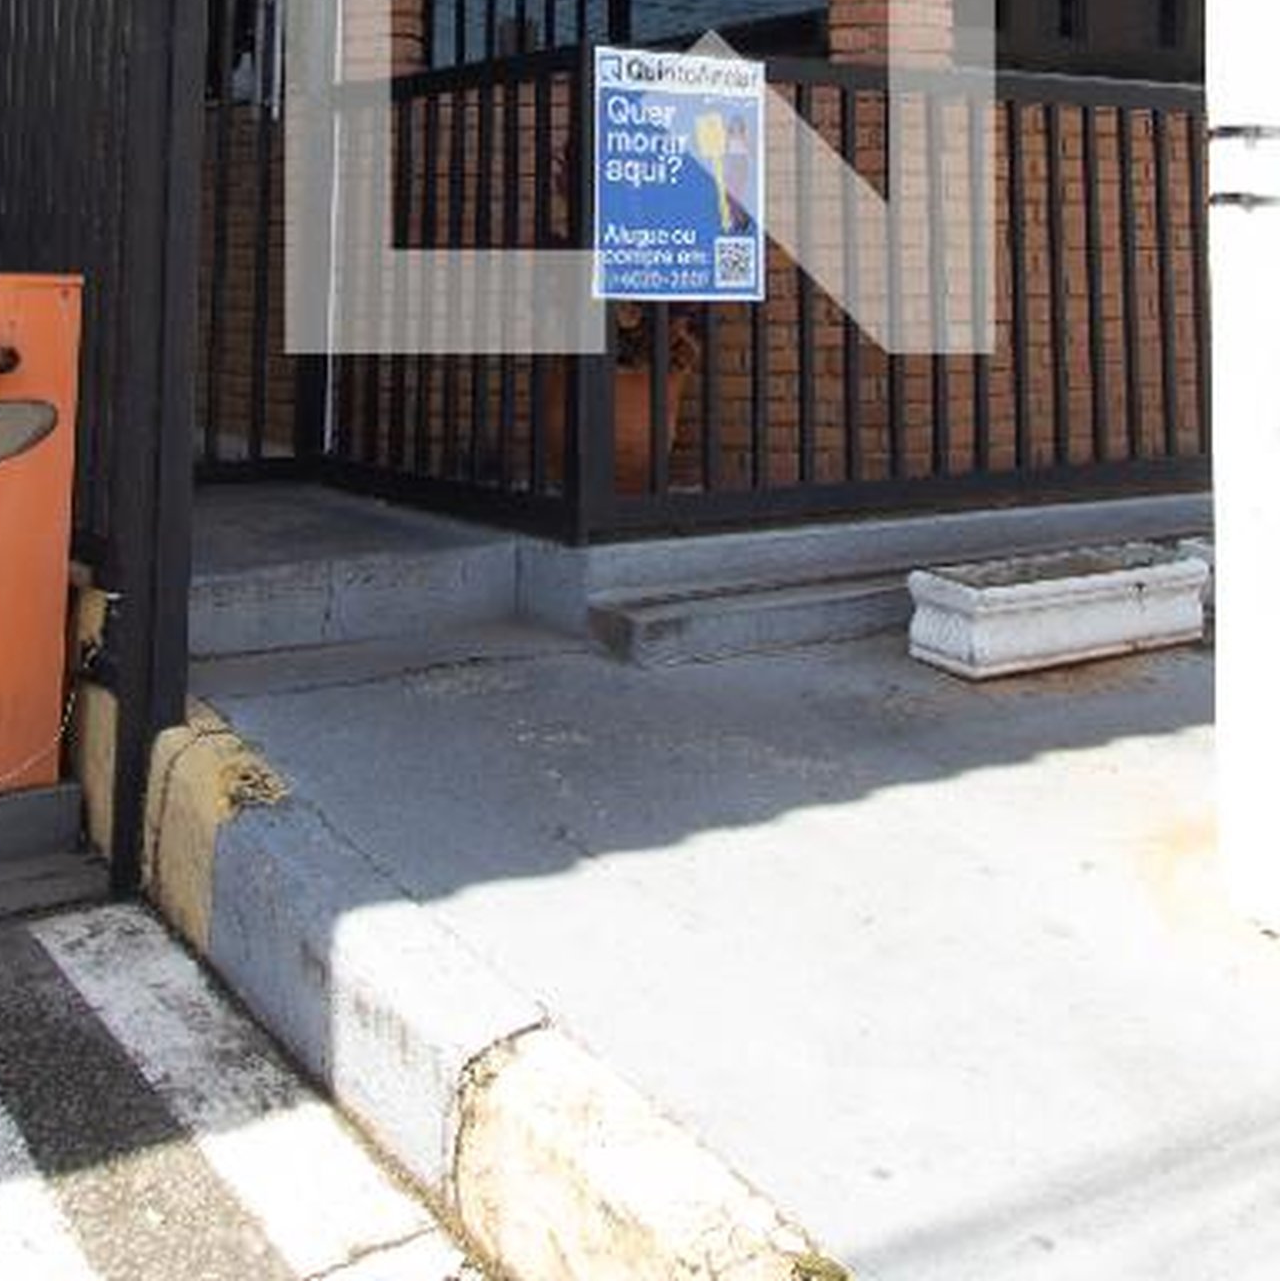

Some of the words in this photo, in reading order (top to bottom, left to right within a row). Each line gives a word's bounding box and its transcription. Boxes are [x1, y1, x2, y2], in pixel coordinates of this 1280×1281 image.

[607, 96, 676, 127] Quer
[607, 128, 686, 155] morar
[607, 148, 682, 187] aqui?
